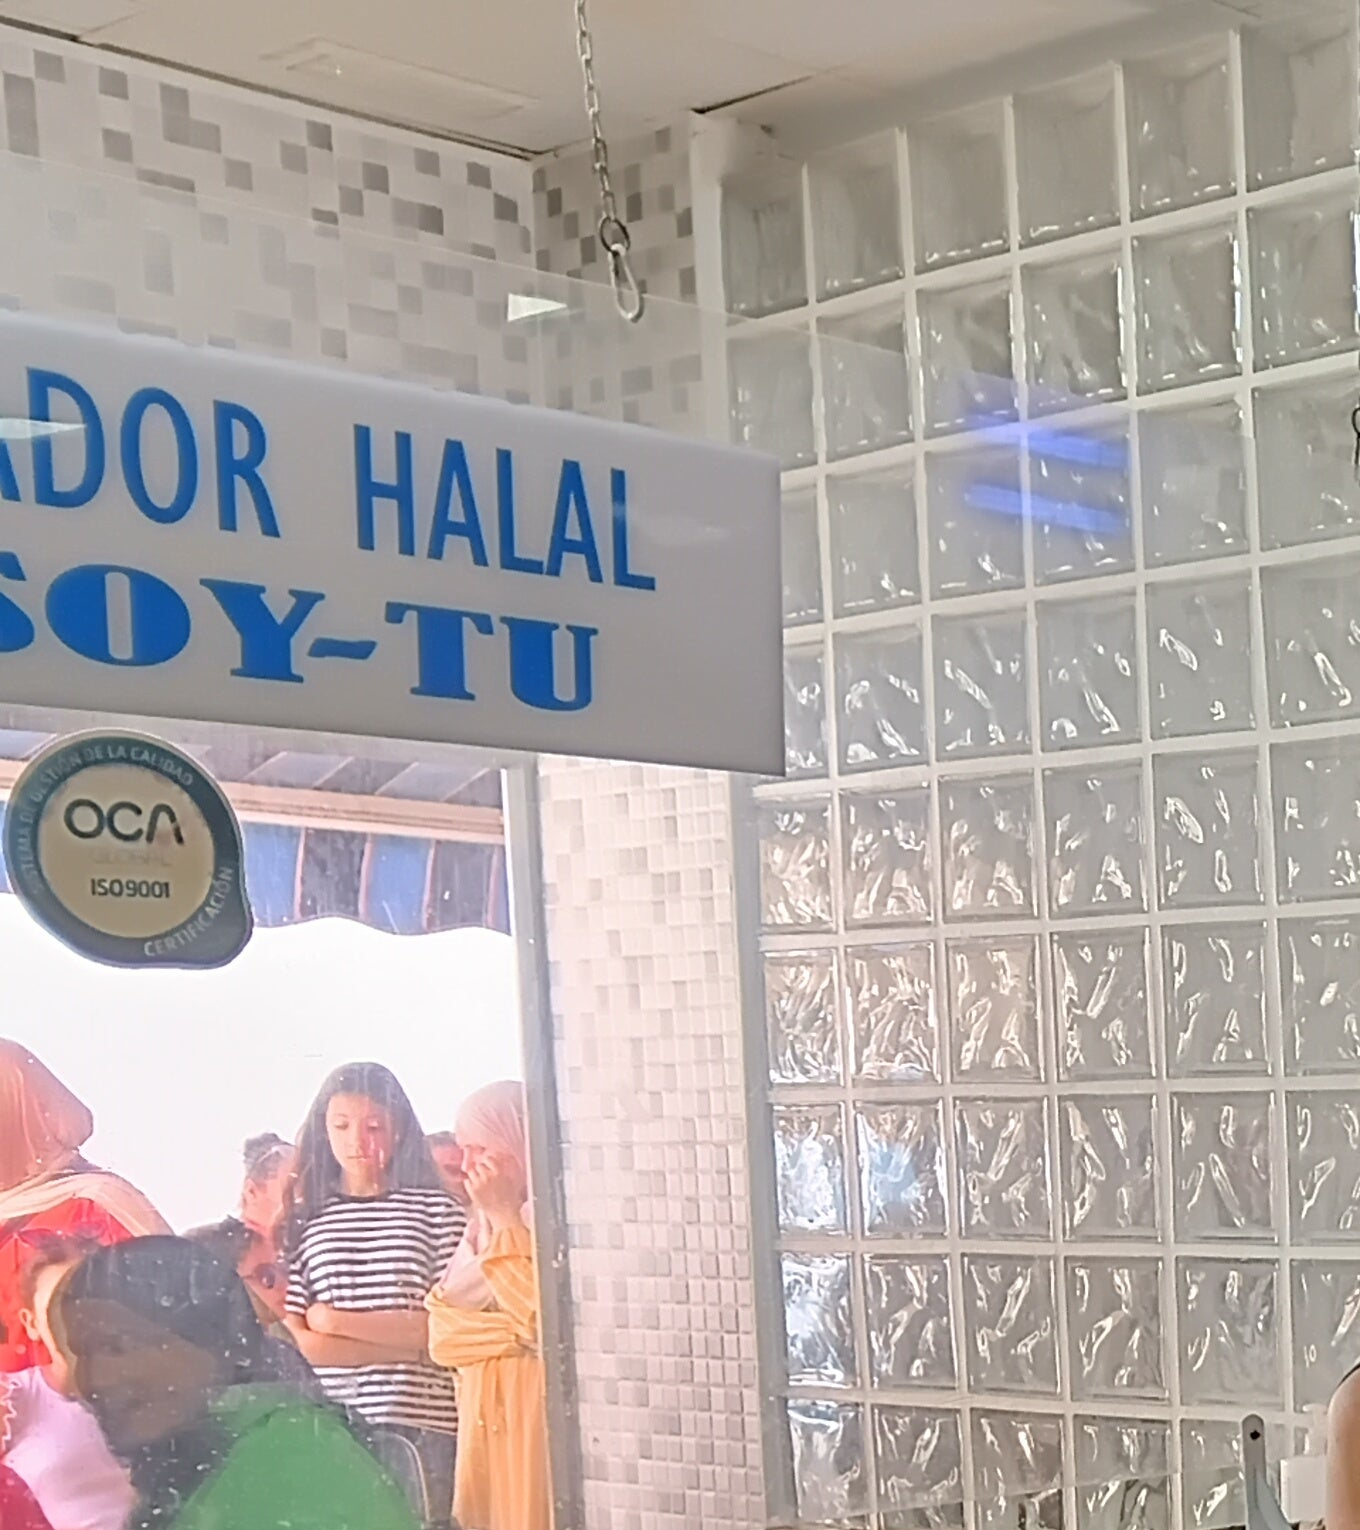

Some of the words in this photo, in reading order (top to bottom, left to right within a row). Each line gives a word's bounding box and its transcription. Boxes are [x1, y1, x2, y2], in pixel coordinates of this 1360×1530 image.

[353, 422, 657, 592] HALAL
[106, 743, 127, 760] LA
[129, 745, 194, 787] CALIDAD
[63, 797, 185, 845] OCA
[90, 878, 170, 899] ISO9001
[143, 865, 234, 957] CERTIFICACIÓN
